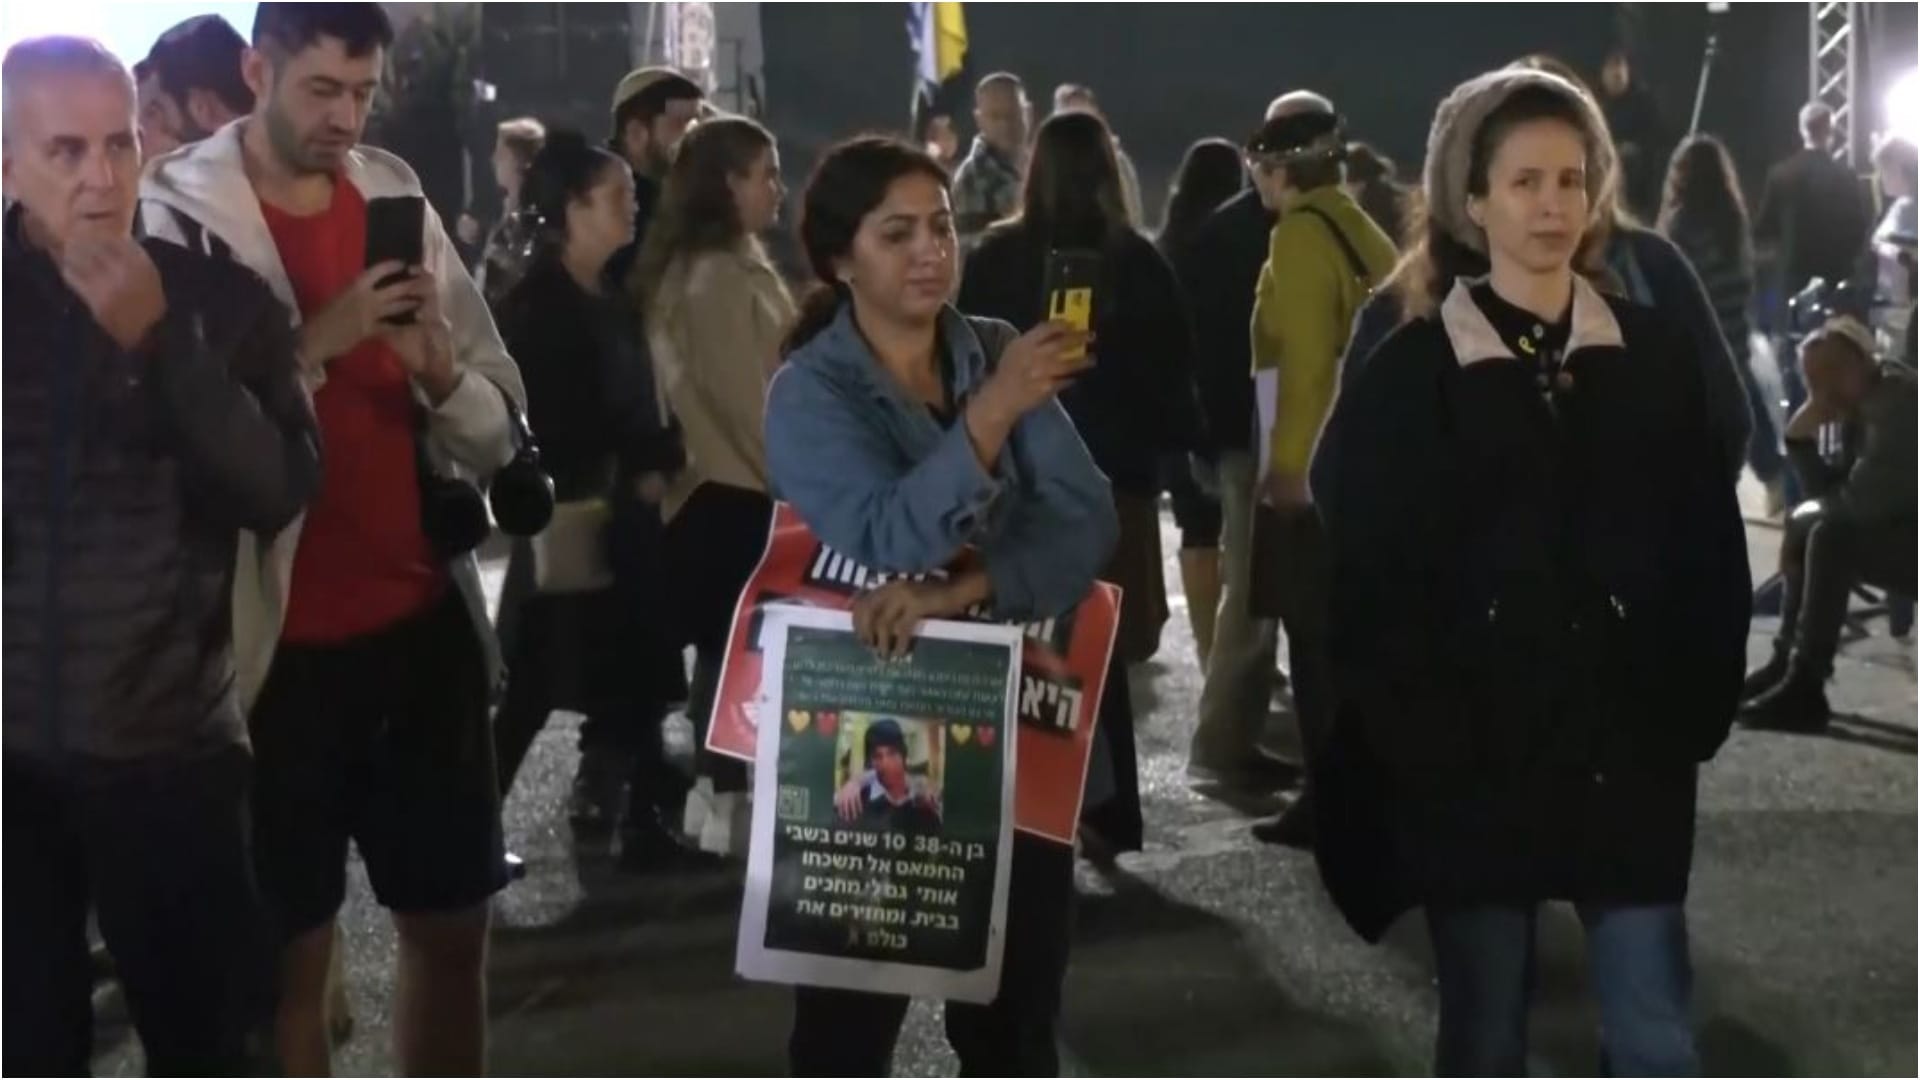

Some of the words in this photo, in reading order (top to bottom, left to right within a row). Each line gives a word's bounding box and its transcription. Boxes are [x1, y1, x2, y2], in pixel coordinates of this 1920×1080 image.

[1021, 676, 1083, 730] היא
[785, 825, 830, 843] בשבי
[834, 828, 878, 848] שנים
[882, 832, 907, 849] 10
[802, 850, 863, 870] תשכחו
[966, 843, 985, 860] בן
[867, 853, 891, 874] אל
[895, 859, 965, 881] החמאס
[803, 875, 861, 894] מחכים
[885, 882, 908, 899] גם
[916, 886, 958, 906] אותי
[796, 898, 825, 916] את
